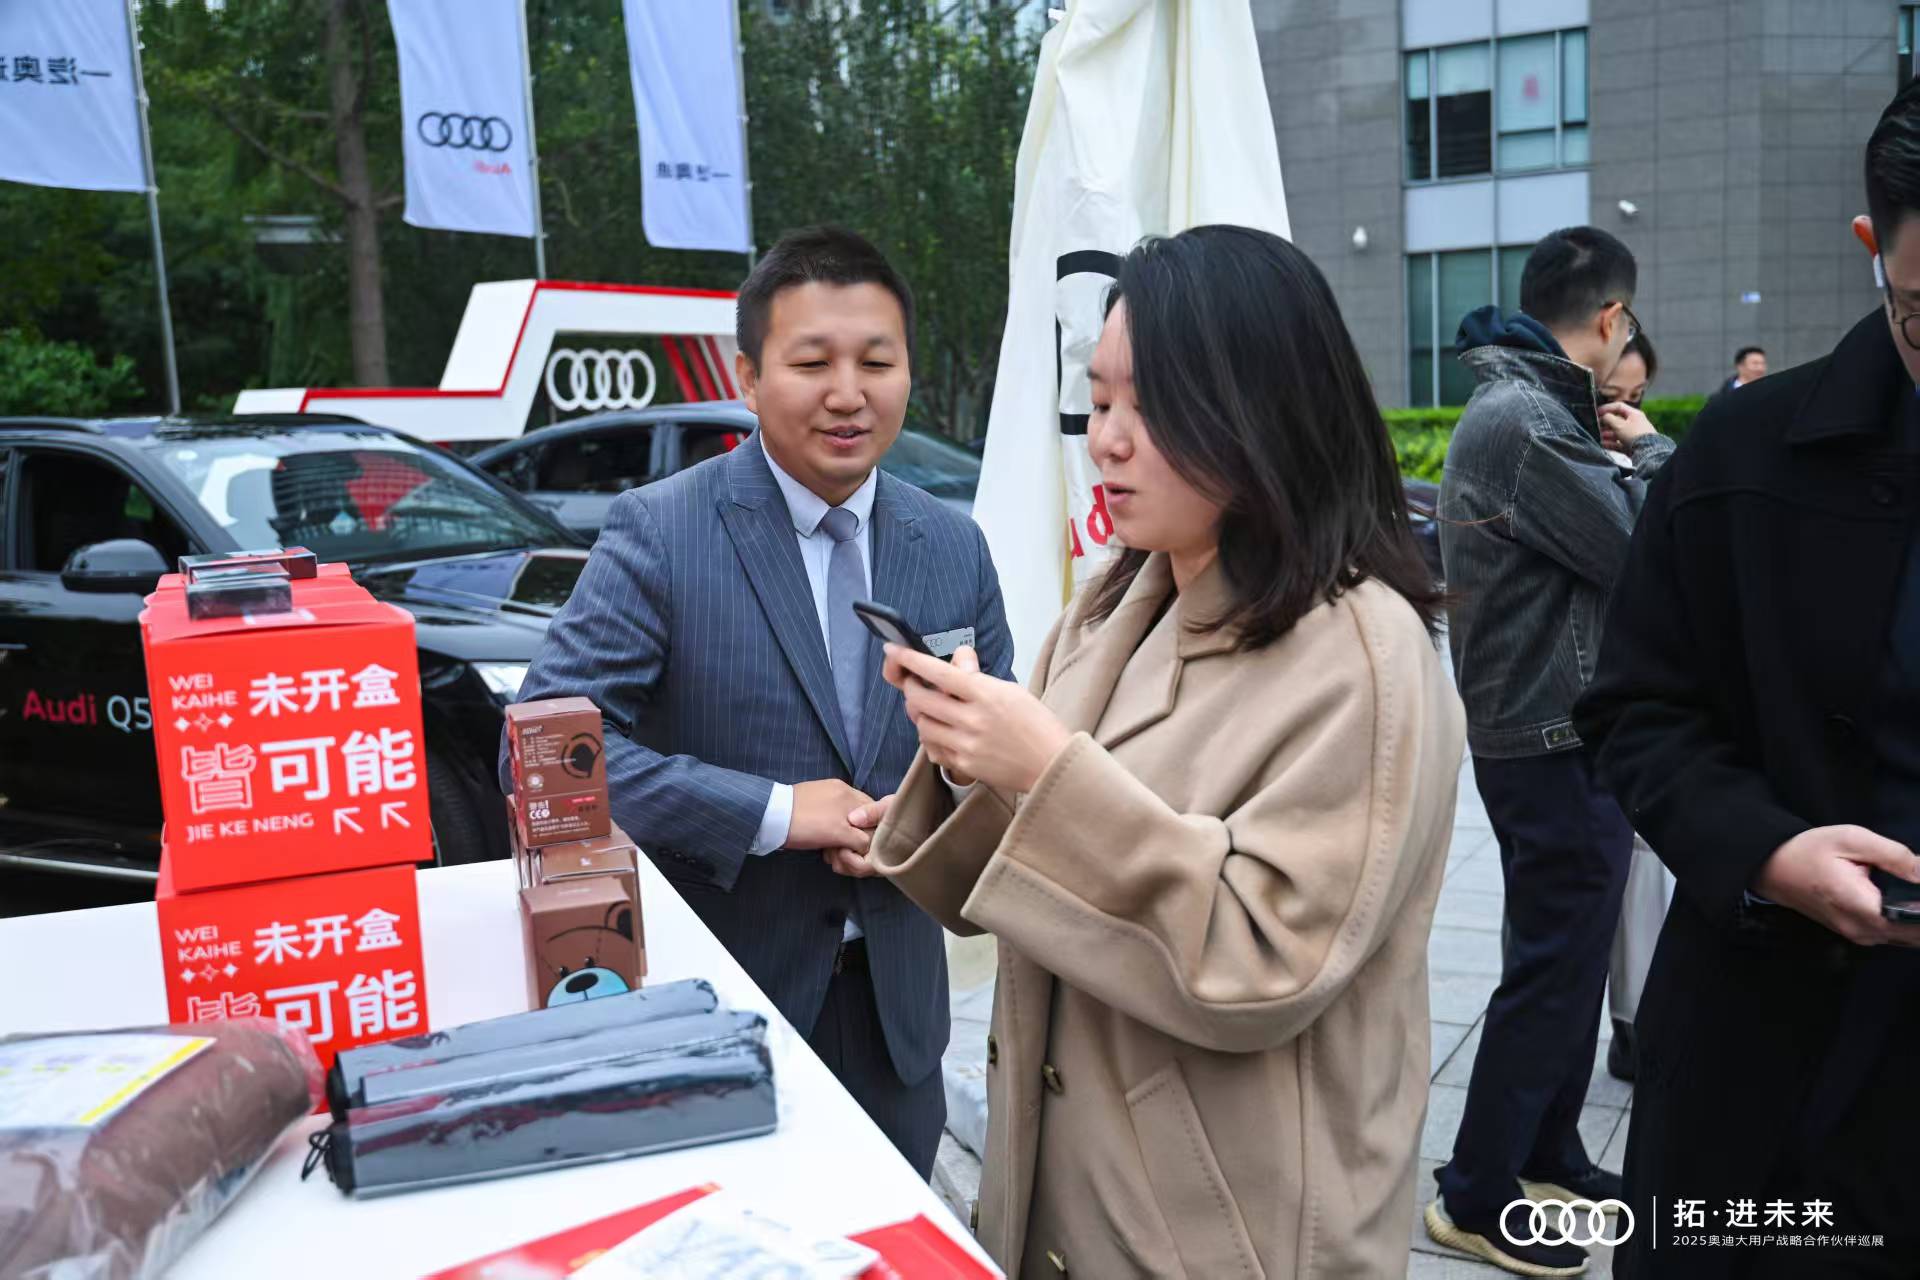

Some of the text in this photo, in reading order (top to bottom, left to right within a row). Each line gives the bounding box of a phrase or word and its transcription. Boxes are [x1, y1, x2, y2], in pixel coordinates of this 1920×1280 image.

[169, 673, 213, 691] WEI
[249, 663, 400, 717] 未开盒
[22, 689, 153, 734] Audi Q5
[171, 691, 238, 710] KAIHE
[181, 728, 417, 815] 皆可能
[186, 813, 314, 843] JIE KE NENG
[175, 926, 218, 943] WEI
[253, 908, 402, 965] 未开盒
[178, 942, 242, 962] KAIHE
